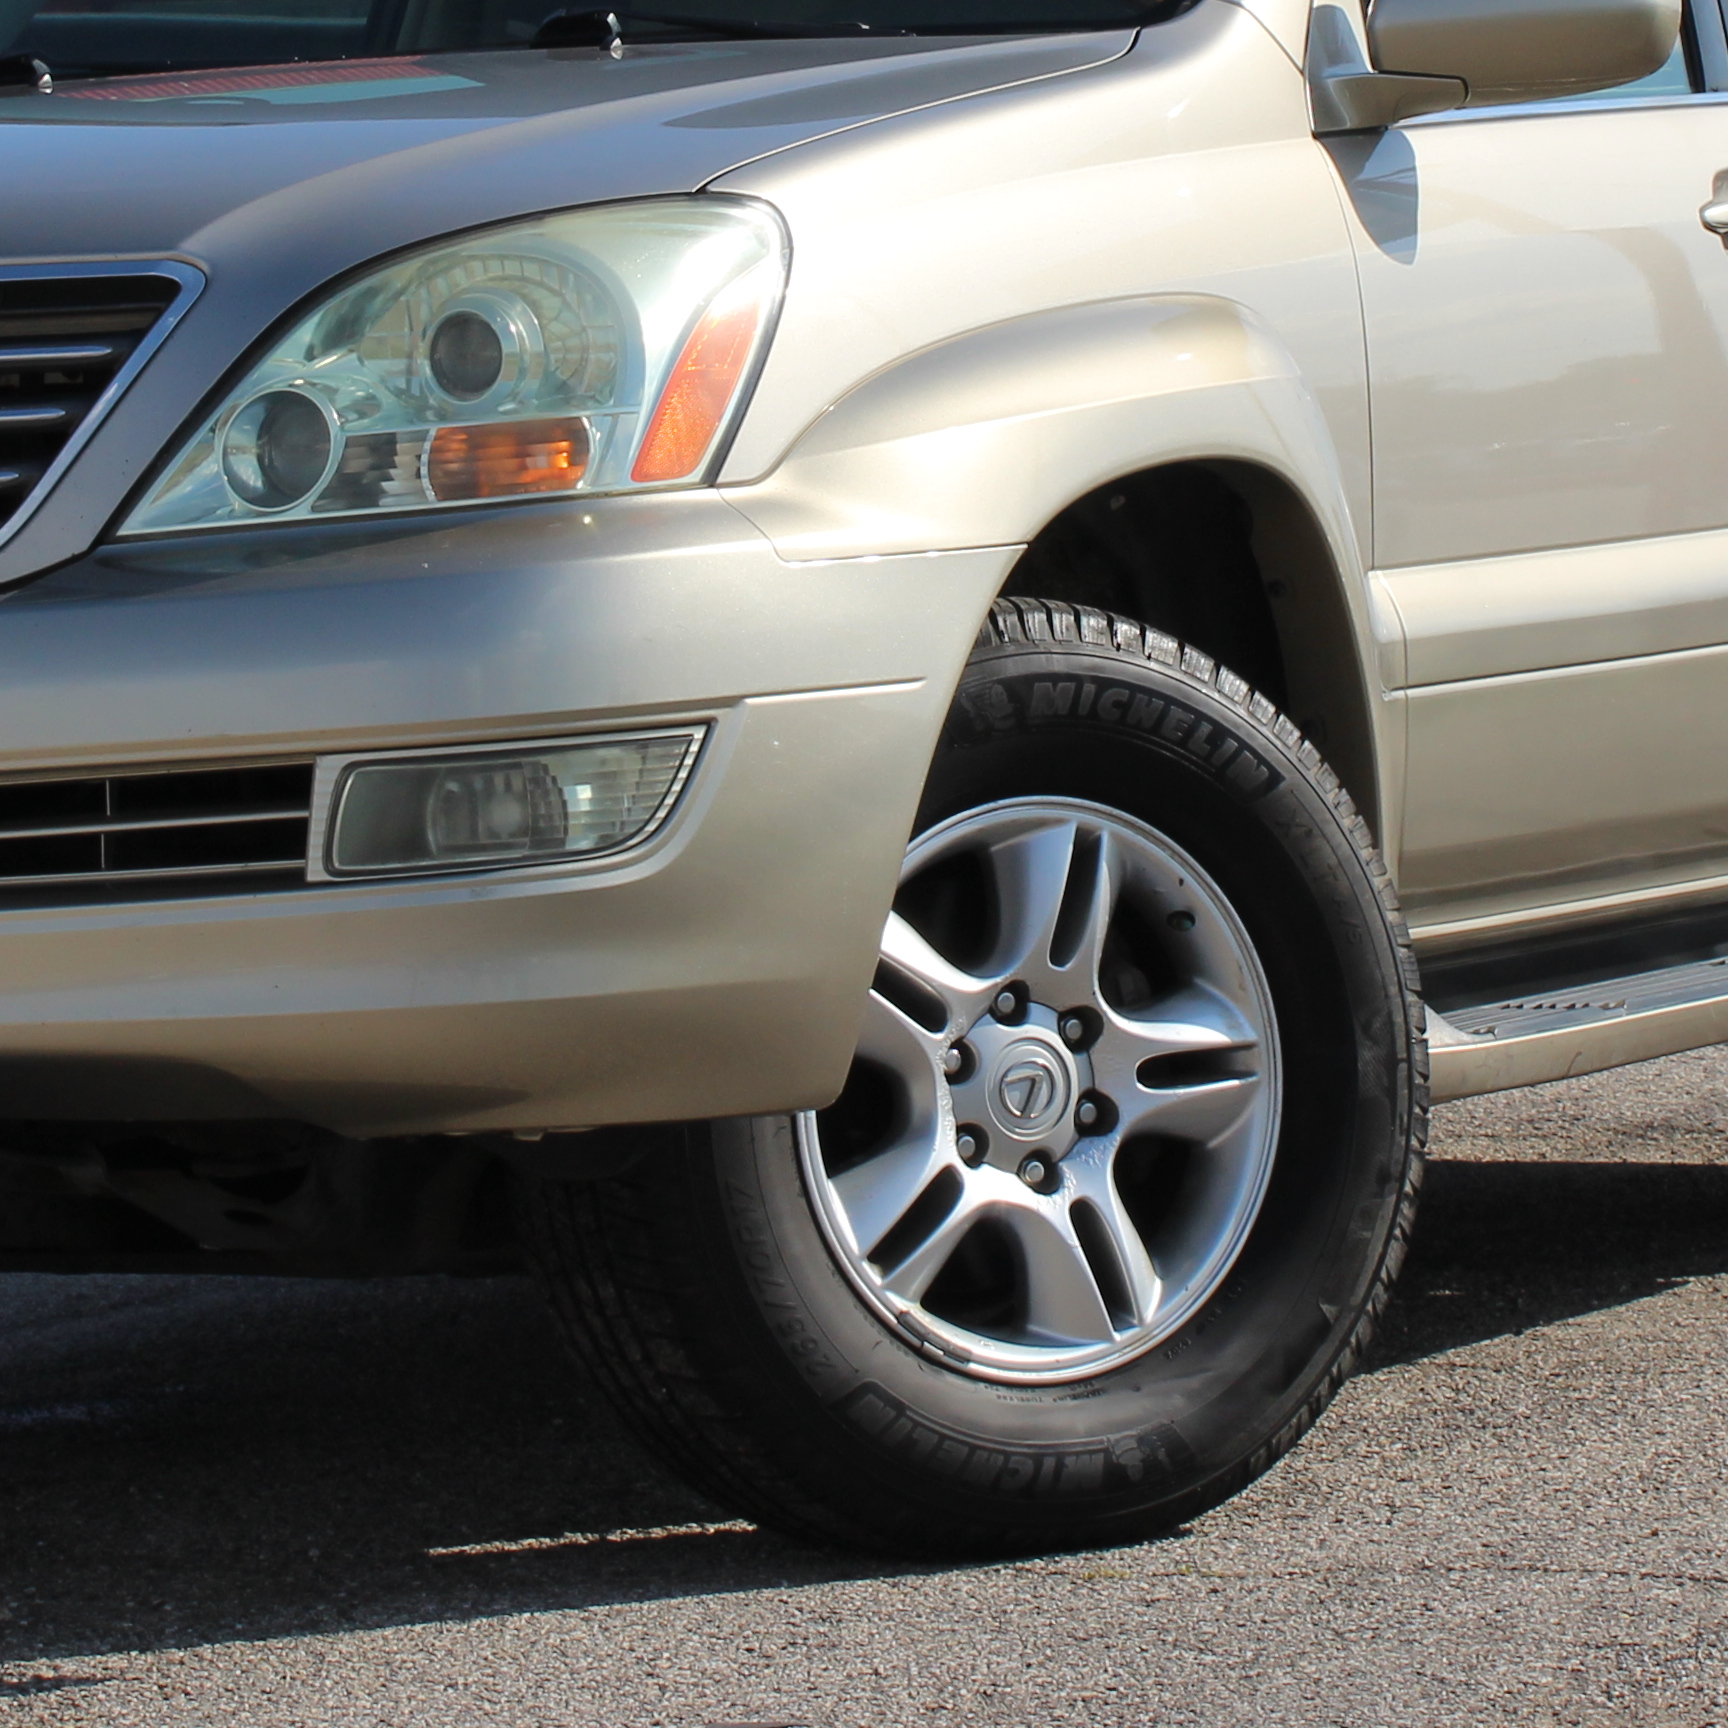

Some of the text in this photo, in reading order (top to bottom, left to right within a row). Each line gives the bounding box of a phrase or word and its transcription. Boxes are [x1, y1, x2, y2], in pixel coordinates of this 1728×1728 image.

[1028, 680, 1273, 797] MICHELIN
[725, 1177, 836, 1378] 265/70R17
[844, 1392, 1105, 1491] MICHELIN
